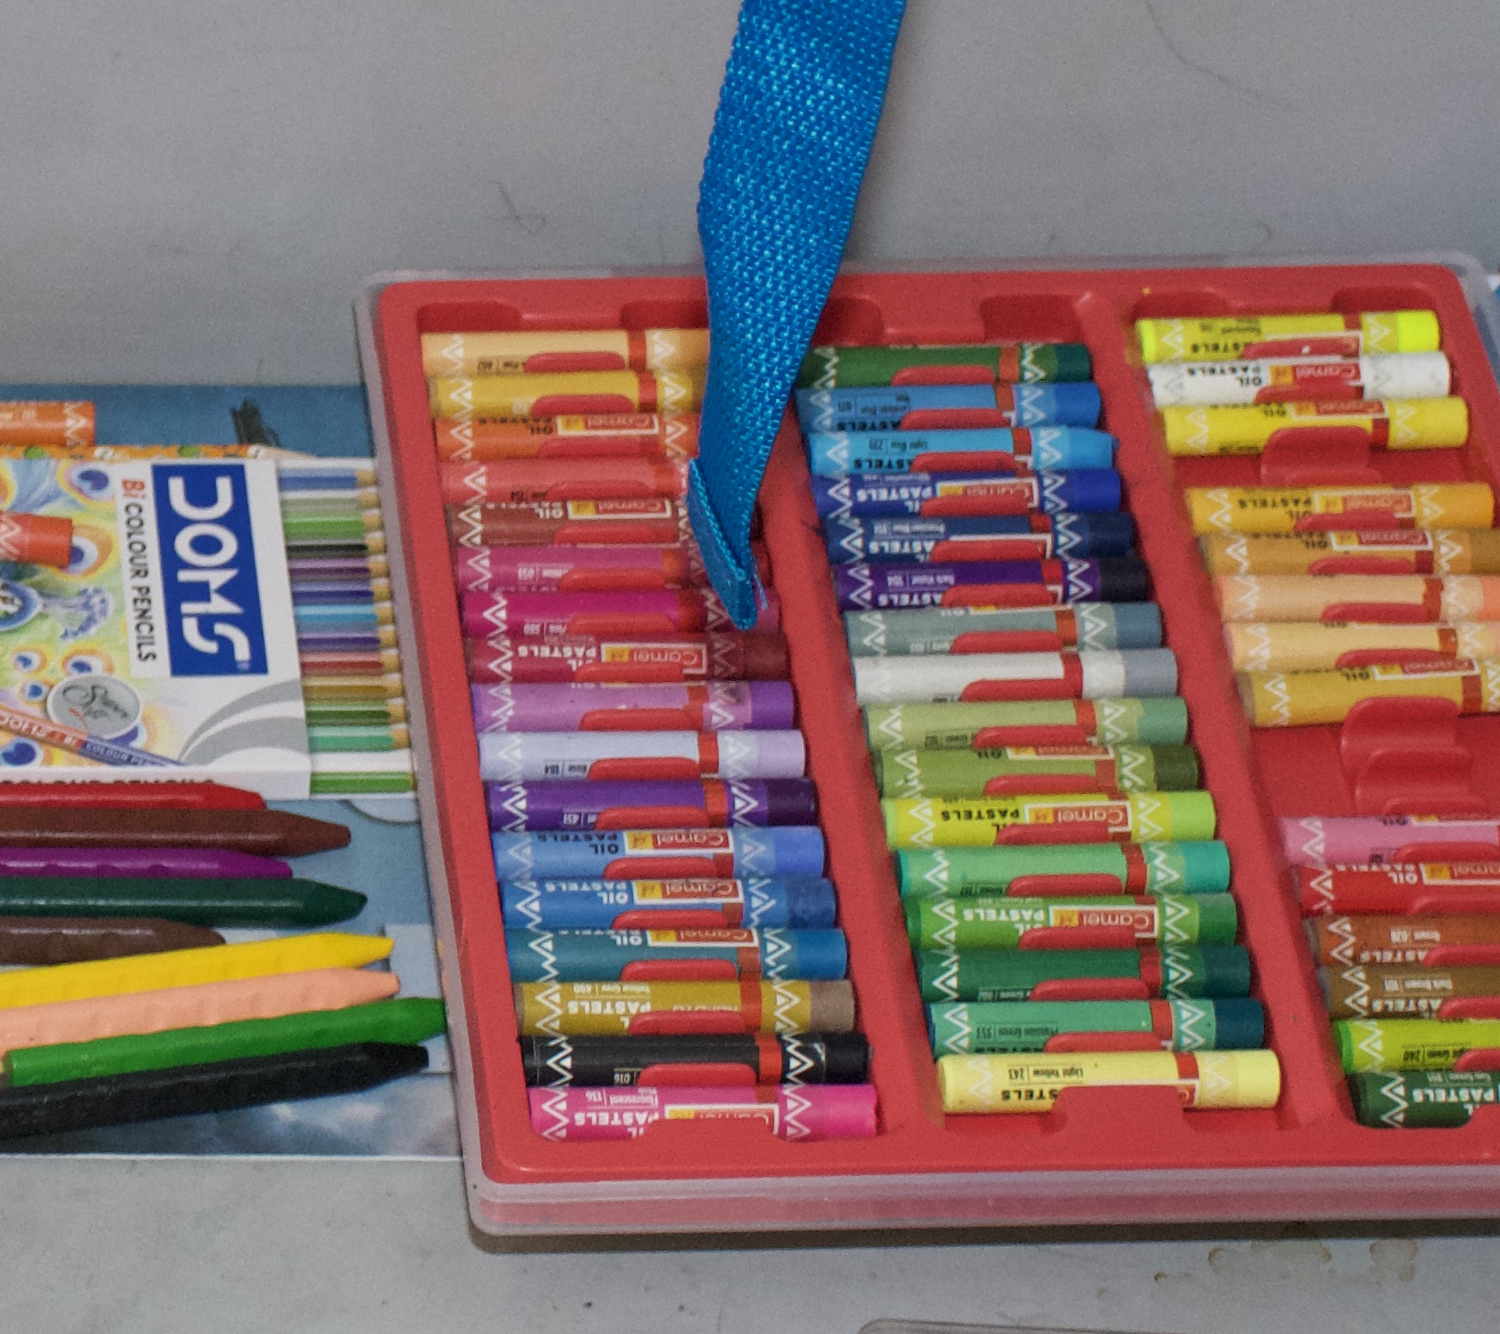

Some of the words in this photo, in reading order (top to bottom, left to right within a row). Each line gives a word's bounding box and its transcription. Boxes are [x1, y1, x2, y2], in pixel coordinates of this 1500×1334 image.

[1296, 366, 1356, 380] Camel
[1236, 376, 1262, 387] OIL
[854, 459, 911, 470] ASTELS
[857, 487, 931, 501] PASTELS
[1238, 498, 1312, 509] PASTELS
[1345, 496, 1406, 510] Camel
[537, 507, 562, 518] OIL
[124, 501, 150, 580] COLOUR
[869, 540, 934, 553] ASTELS
[1301, 539, 1328, 551] OIL
[168, 476, 251, 662] DOMS
[878, 593, 942, 606] ASTELS
[131, 584, 158, 663] PENCILS
[518, 645, 597, 657] PASTELS
[633, 650, 698, 666] Camel
[941, 808, 1019, 820] PASTELS
[1057, 809, 1124, 823] Camel
[656, 833, 724, 846] Camel
[590, 844, 619, 854] OIL
[1388, 872, 1418, 884] OIL
[544, 882, 628, 892] PASTELS
[666, 883, 732, 896] Camel
[598, 892, 628, 904] OIL
[962, 908, 1044, 921] PASTELS
[1083, 913, 1150, 928] Camel
[611, 935, 642, 945] OIL
[1360, 950, 1427, 962] ASTELS
[568, 1000, 651, 1013] PASTELS
[1372, 998, 1441, 1012] ASTELS
[1008, 1068, 1025, 1080] 243
[1033, 1067, 1061, 1080] Yellow
[1062, 1067, 1084, 1079] Light
[1001, 1089, 1059, 1101] STELS
[1413, 1088, 1495, 1102] PASTELS
